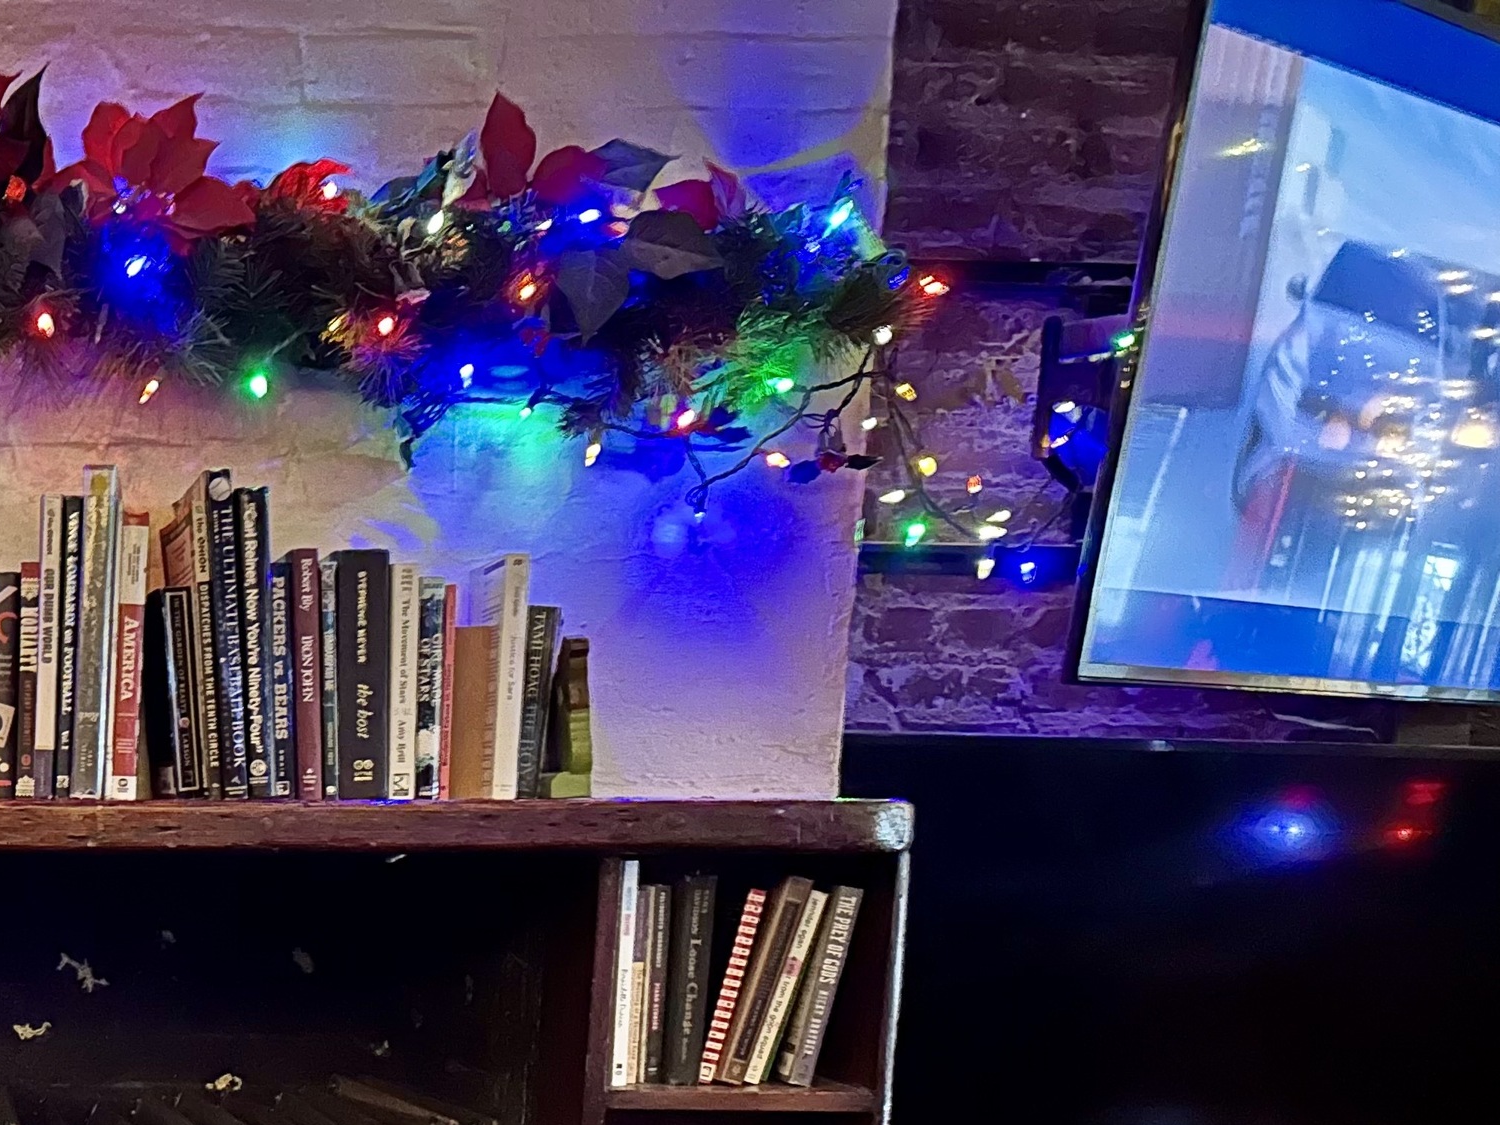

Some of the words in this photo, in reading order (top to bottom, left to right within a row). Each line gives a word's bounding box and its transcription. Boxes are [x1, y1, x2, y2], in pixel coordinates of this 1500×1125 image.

[66, 511, 79, 552] VINCE
[220, 505, 233, 542] THE
[243, 540, 257, 585] Reiner,
[300, 558, 311, 592] Robert
[63, 555, 77, 627] LOMBARDI
[222, 545, 238, 631] ULTIMATE
[245, 588, 258, 620] Now
[299, 595, 311, 611] Bly
[199, 584, 211, 643] DISPATCHES
[271, 576, 286, 656] PACKERS
[401, 598, 410, 617] The
[19, 606, 37, 672] MORIARTY
[41, 627, 51, 663] WORLD
[246, 622, 259, 664] You're
[399, 619, 409, 667] Movement
[420, 637, 431, 652] OF
[530, 610, 546, 650] TAMI
[120, 616, 138, 701] AMERICA
[175, 630, 183, 666] GARDEN
[202, 646, 213, 674] FROM
[300, 635, 313, 666] IRON
[61, 646, 73, 715] FOOTBALL
[227, 634, 243, 718] BASEBALL
[273, 660, 283, 678] vs.
[301, 668, 313, 702] JOHN
[399, 669, 409, 678] of
[418, 658, 431, 701] STARS
[507, 667, 515, 678] for
[526, 655, 542, 698] HOAG
[179, 683, 187, 713] BEASTS
[204, 676, 214, 696] THE
[356, 684, 372, 705] the
[399, 680, 408, 704] Stars
[506, 681, 515, 700] Sara
[206, 698, 216, 729] TENTH
[274, 683, 288, 739] BEARS
[523, 702, 537, 734] THE
[231, 720, 245, 767] BOOK
[396, 719, 407, 739] Amy
[182, 733, 191, 766] LARSON
[208, 732, 218, 767] CIRCLE
[803, 897, 819, 927] jennifer
[836, 893, 857, 917] THE
[794, 928, 807, 949] egan
[829, 915, 851, 943] PREY
[684, 938, 702, 979] Loose
[825, 942, 844, 957] OF
[818, 956, 840, 985] GODS
[778, 980, 789, 999] from
[679, 981, 699, 1035] Change
[773, 999, 782, 1013] the
[763, 1013, 776, 1034] goon
[755, 1035, 769, 1059] squad
